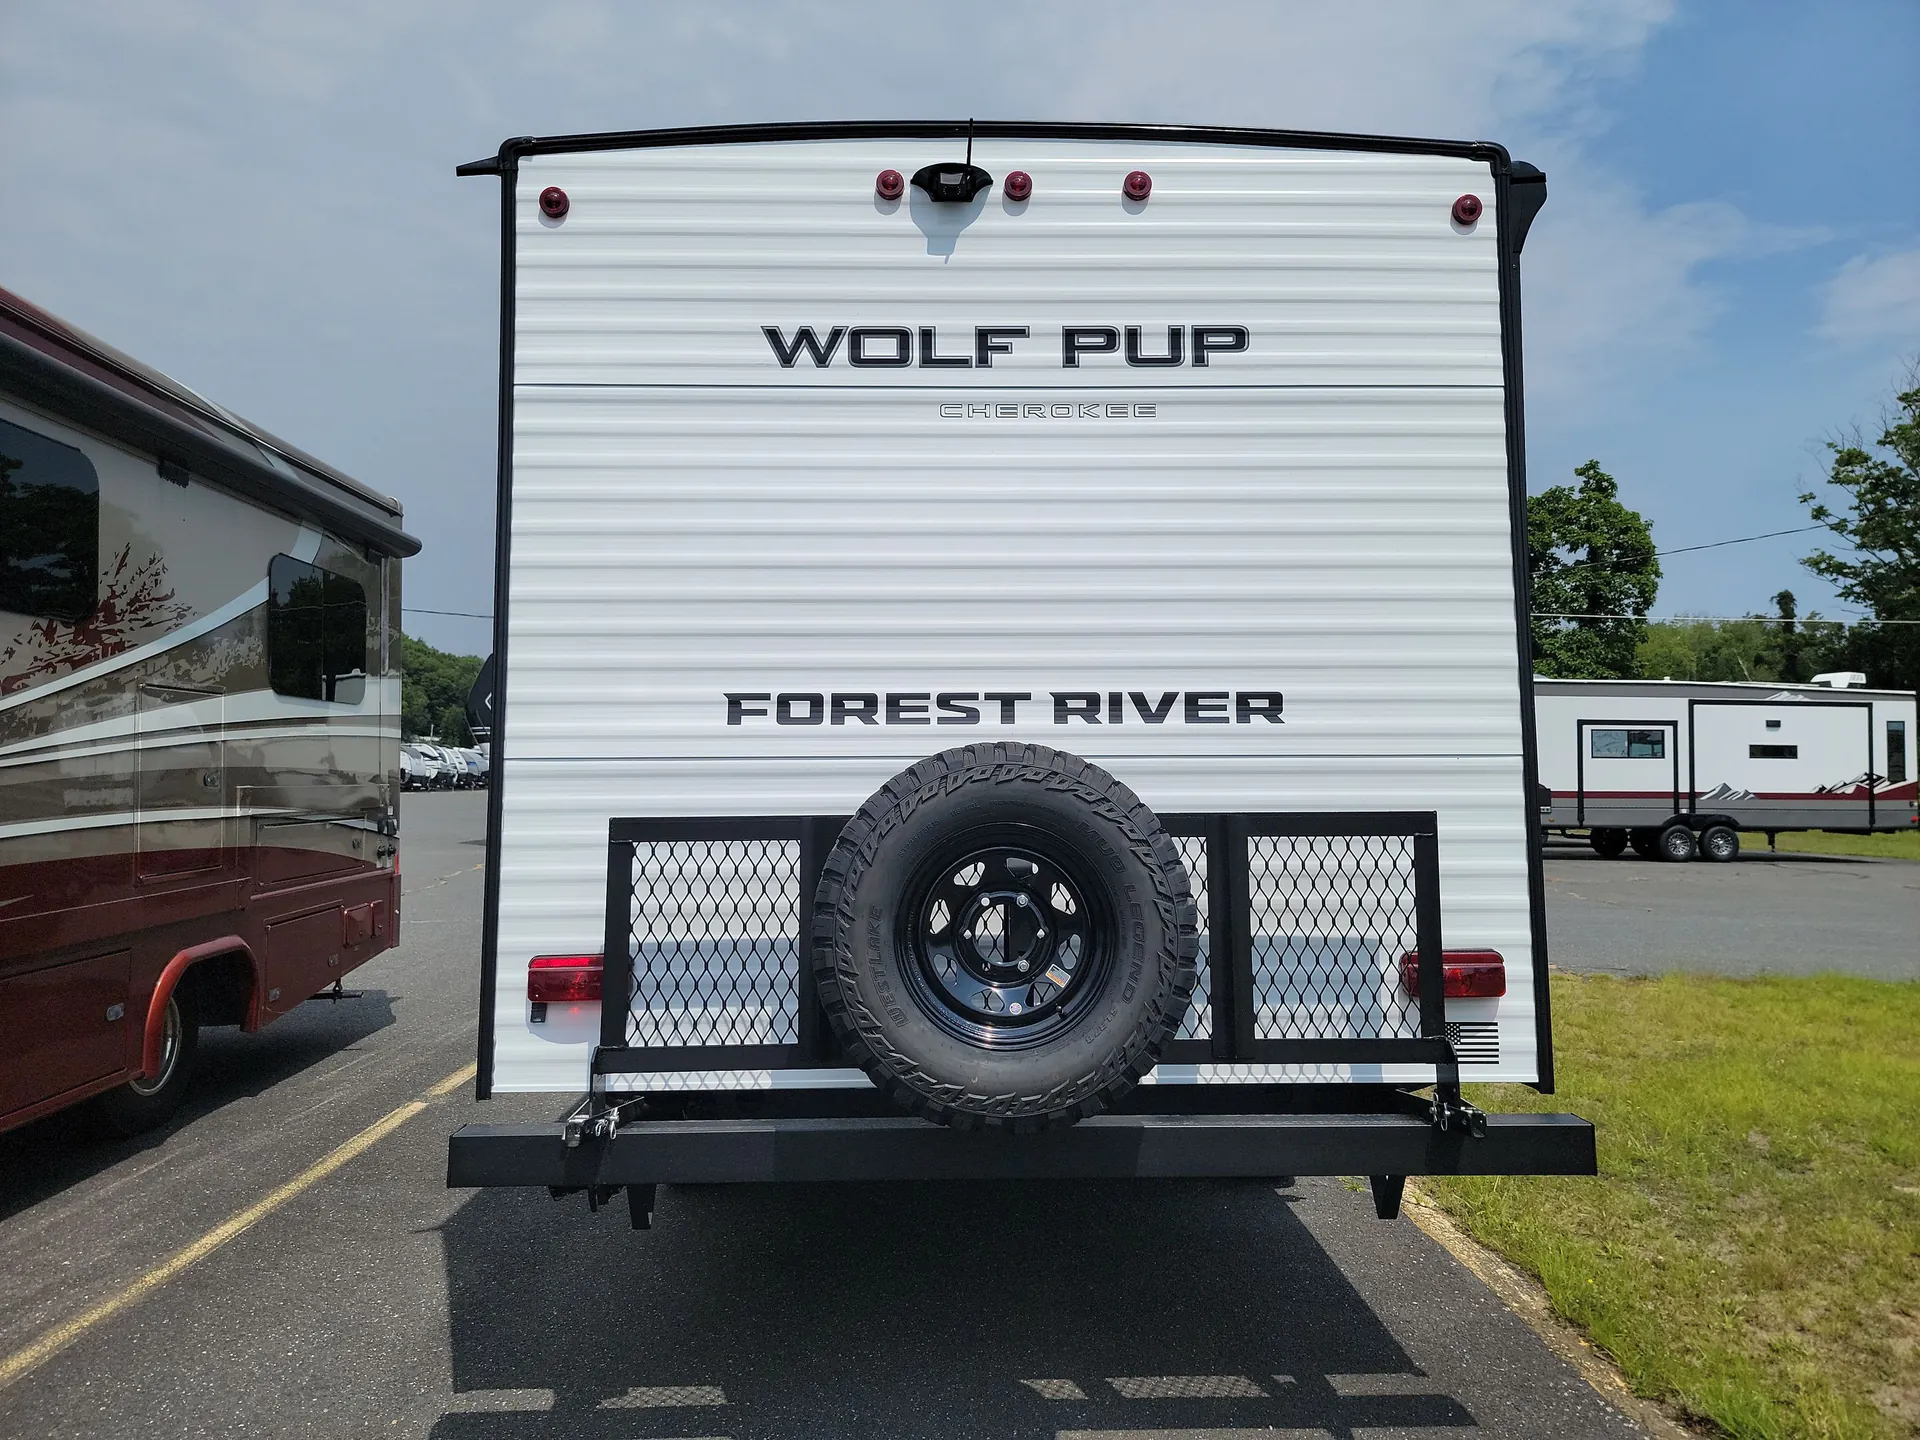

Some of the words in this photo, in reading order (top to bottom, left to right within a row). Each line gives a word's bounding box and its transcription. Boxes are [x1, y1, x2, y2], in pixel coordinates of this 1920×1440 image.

[760, 325, 1030, 369] WOLF
[1062, 325, 1250, 368] PUP
[939, 402, 1157, 419] CHEROKEE
[723, 691, 1032, 726] FOREST
[1048, 691, 1286, 725] RIVER
[1076, 820, 1126, 874] MUD
[1121, 883, 1146, 1004] LEGEND
[867, 904, 911, 1028] WESTLAKE
